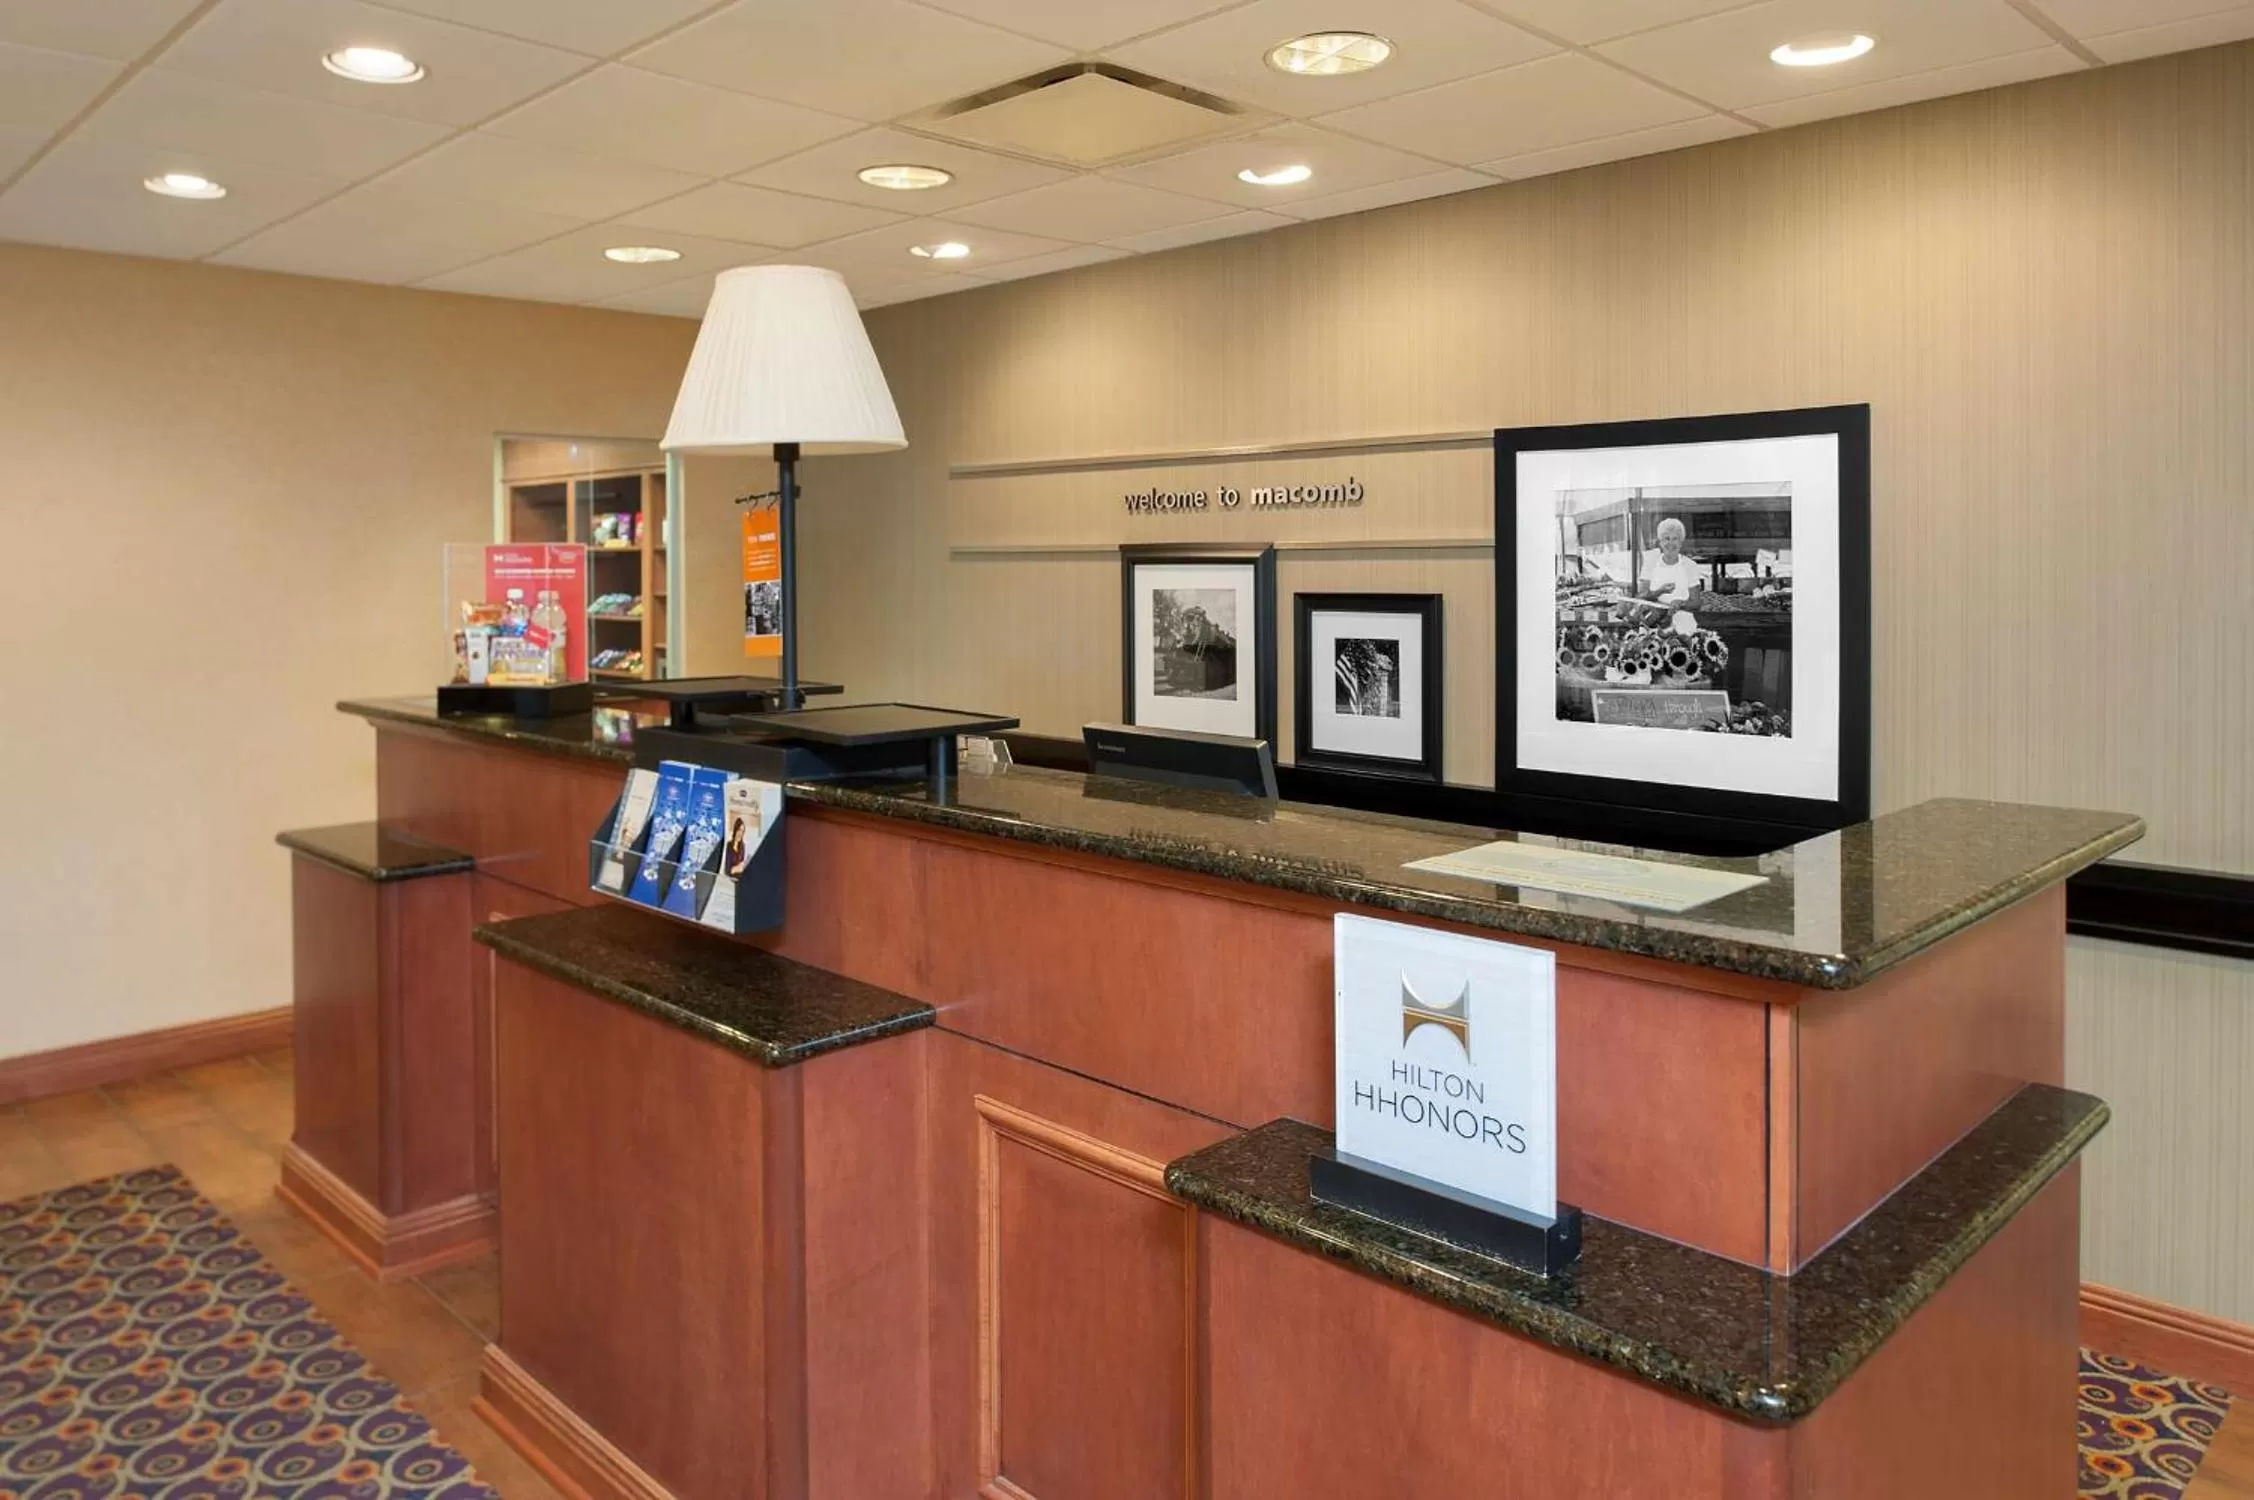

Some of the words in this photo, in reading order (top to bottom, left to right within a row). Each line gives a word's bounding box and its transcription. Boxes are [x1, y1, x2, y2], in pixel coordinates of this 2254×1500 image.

[1125, 487, 1206, 511] welcome
[1216, 486, 1240, 508] to
[1250, 476, 1363, 505] macomb
[1392, 1059, 1484, 1104] HILTON
[1354, 1080, 1526, 1154] HHONORS
